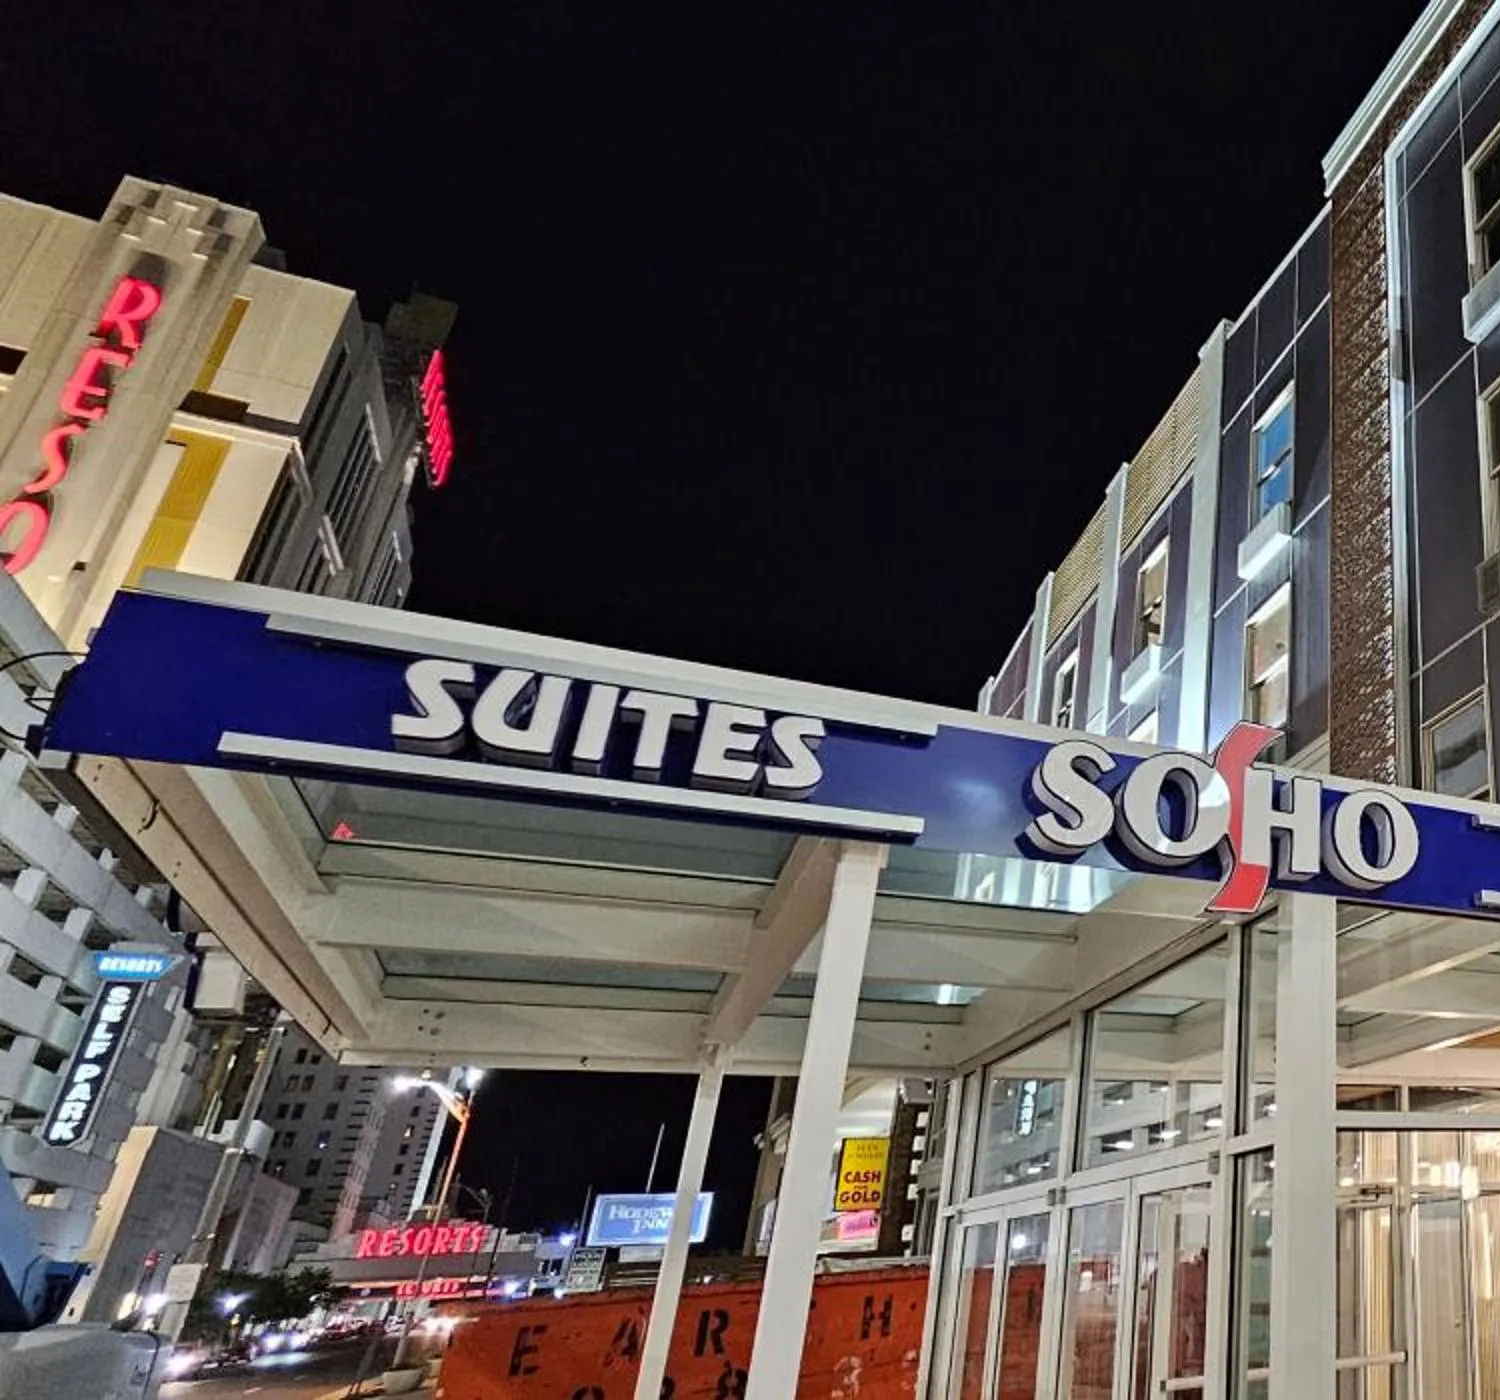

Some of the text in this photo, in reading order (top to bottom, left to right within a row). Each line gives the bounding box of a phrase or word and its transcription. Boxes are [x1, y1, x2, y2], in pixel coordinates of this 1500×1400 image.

[390, 657, 827, 795] SUITES
[1026, 739, 1419, 890] SOHO
[49, 985, 131, 1141] SELF PARK
[839, 1190, 881, 1203] GOLD
[843, 1170, 881, 1184] CASH
[358, 1225, 485, 1258] RESORTS
[507, 1293, 893, 1378] EARH
